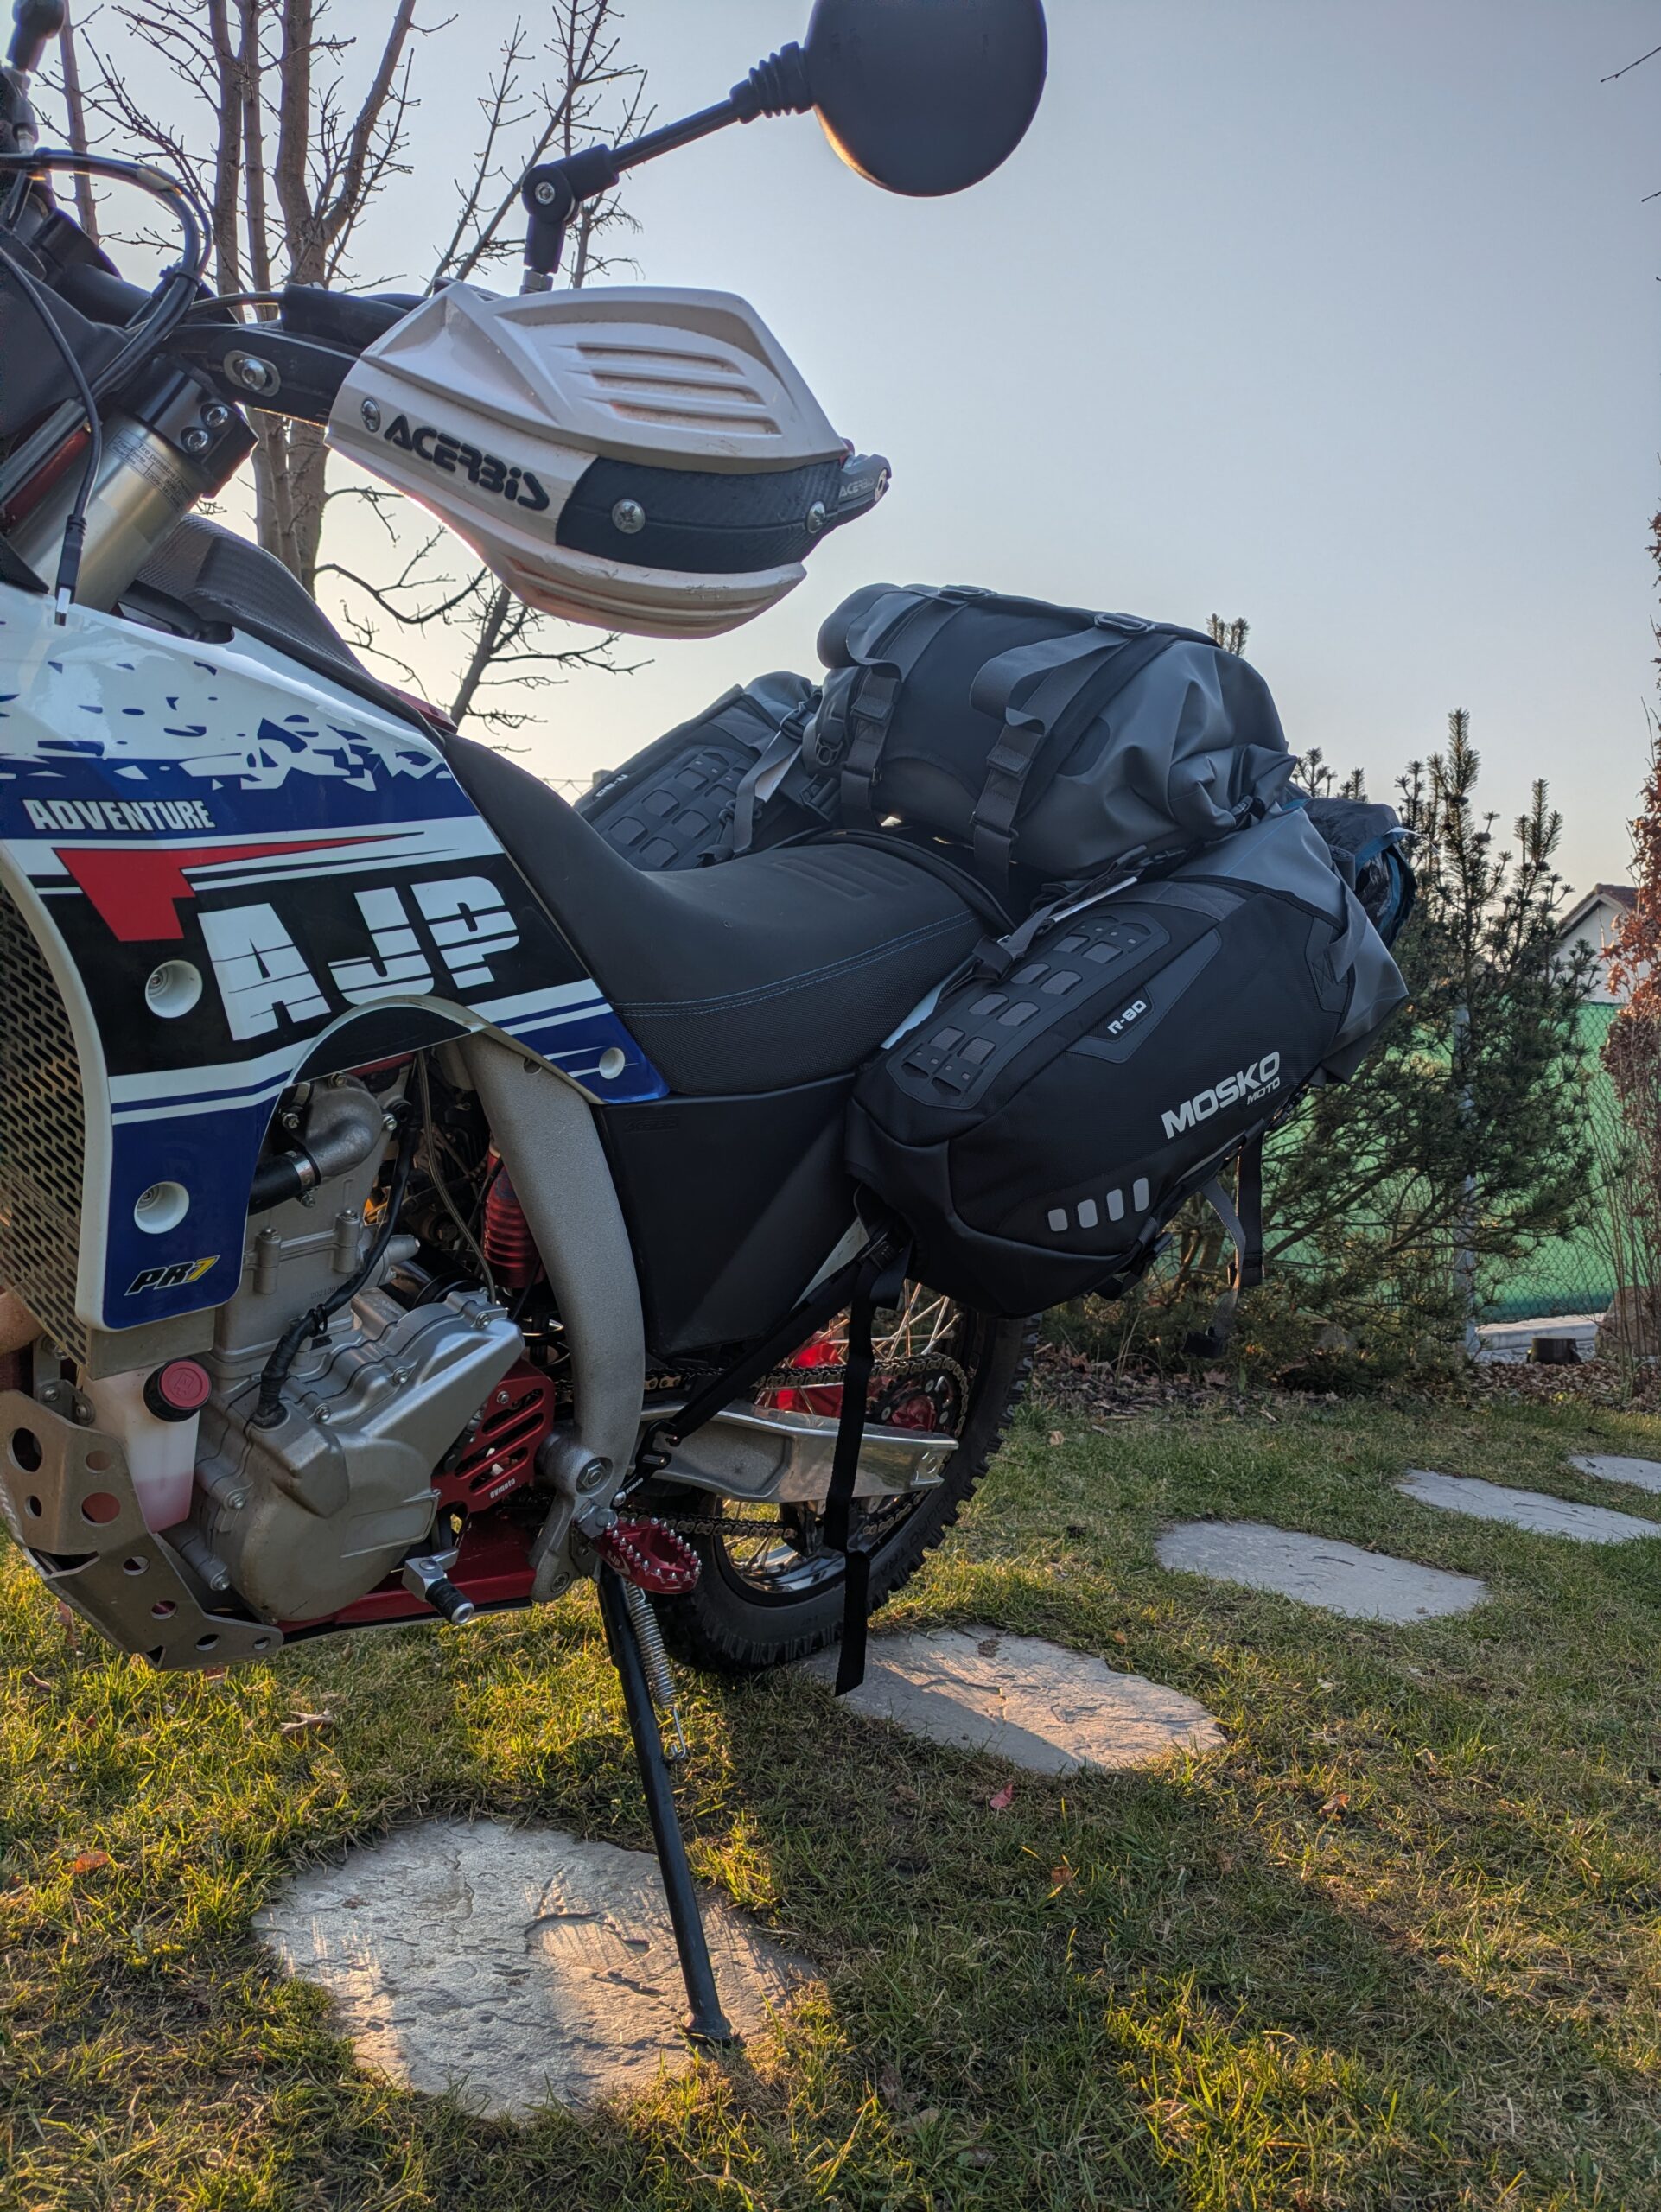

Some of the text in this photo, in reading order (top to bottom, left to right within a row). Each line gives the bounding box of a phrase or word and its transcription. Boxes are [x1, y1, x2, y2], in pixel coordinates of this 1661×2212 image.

[384, 414, 550, 512] ACERBIS
[22, 798, 216, 831] ADVENTURE
[197, 879, 520, 1042] AJP
[1107, 999, 1148, 1035] R-80
[1161, 1051, 1281, 1140] MOSKO
[1246, 1077, 1281, 1106] MOTO
[124, 1255, 220, 1296] PR7
